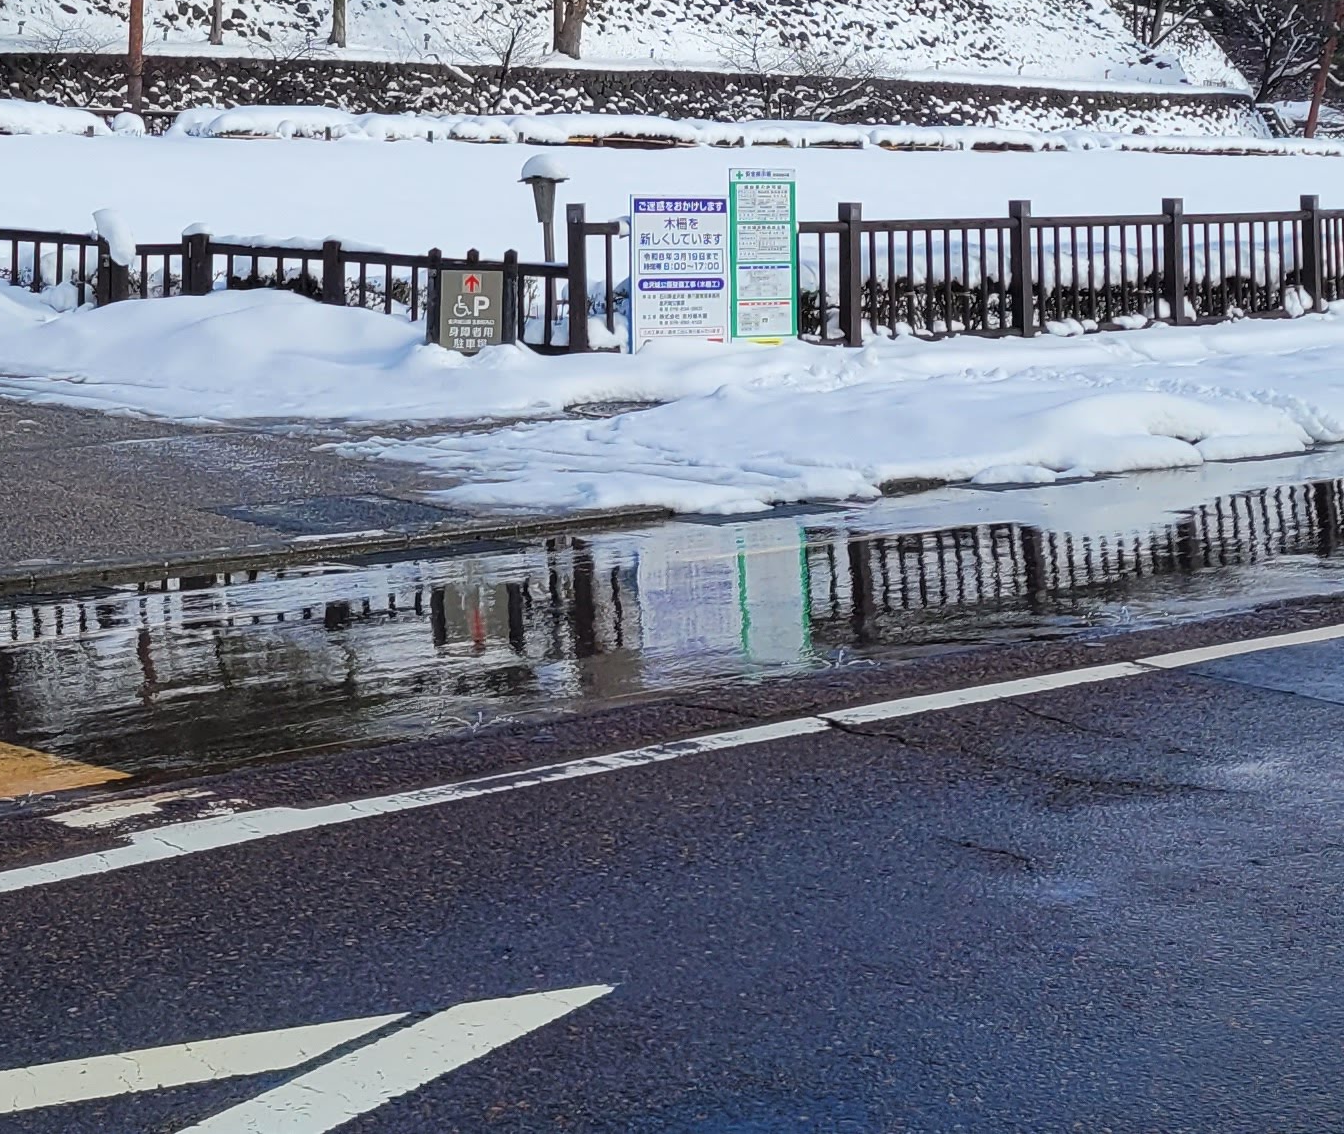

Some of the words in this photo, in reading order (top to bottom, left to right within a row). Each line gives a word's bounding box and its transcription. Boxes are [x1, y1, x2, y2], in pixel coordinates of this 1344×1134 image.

[638, 200, 724, 211] ご迷惑をおかけします
[664, 217, 698, 230] 木柵を
[640, 232, 722, 246] 新しくしています
[644, 252, 719, 261] 令和8年3月19日まで
[473, 296, 490, 316] P
